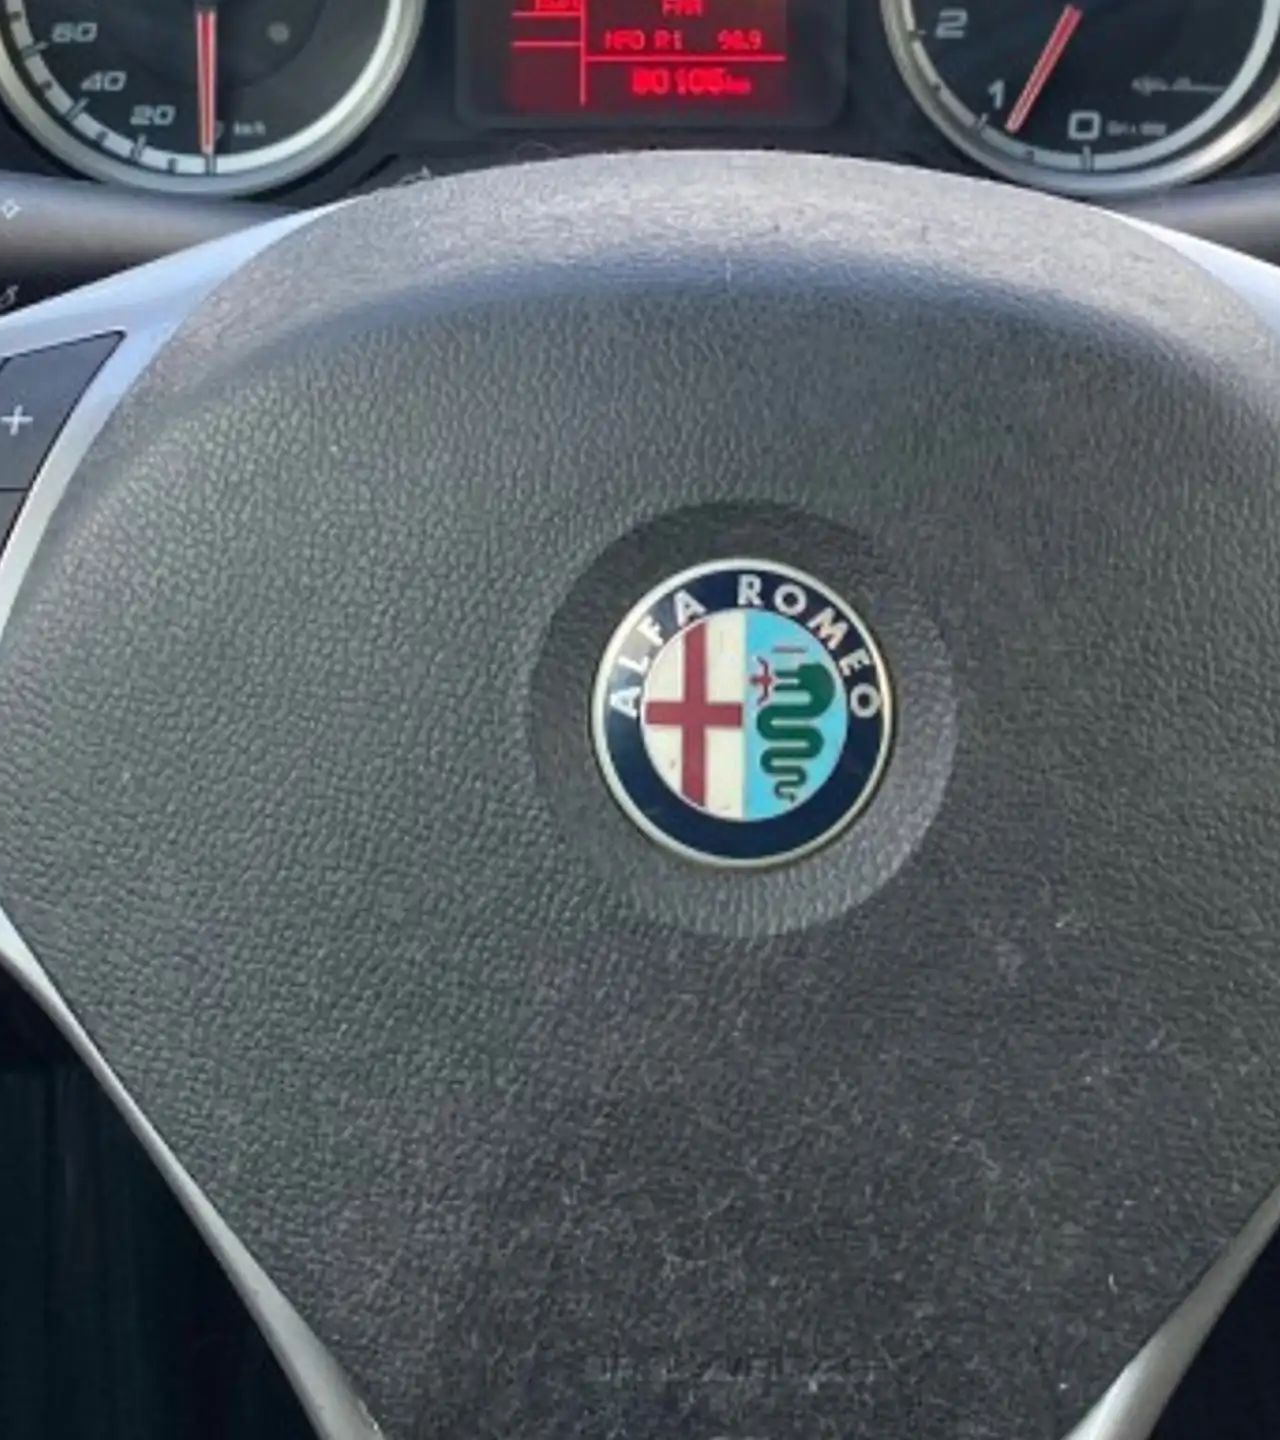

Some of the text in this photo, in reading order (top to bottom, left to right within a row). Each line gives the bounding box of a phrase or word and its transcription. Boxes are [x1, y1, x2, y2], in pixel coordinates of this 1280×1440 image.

[51, 22, 97, 42] 60
[934, 9, 968, 39] 2
[81, 71, 127, 91] 40
[986, 79, 1006, 109] 1
[130, 106, 176, 126] 20
[1067, 110, 1102, 141] 0
[608, 573, 883, 721] ALFA ROMEO
